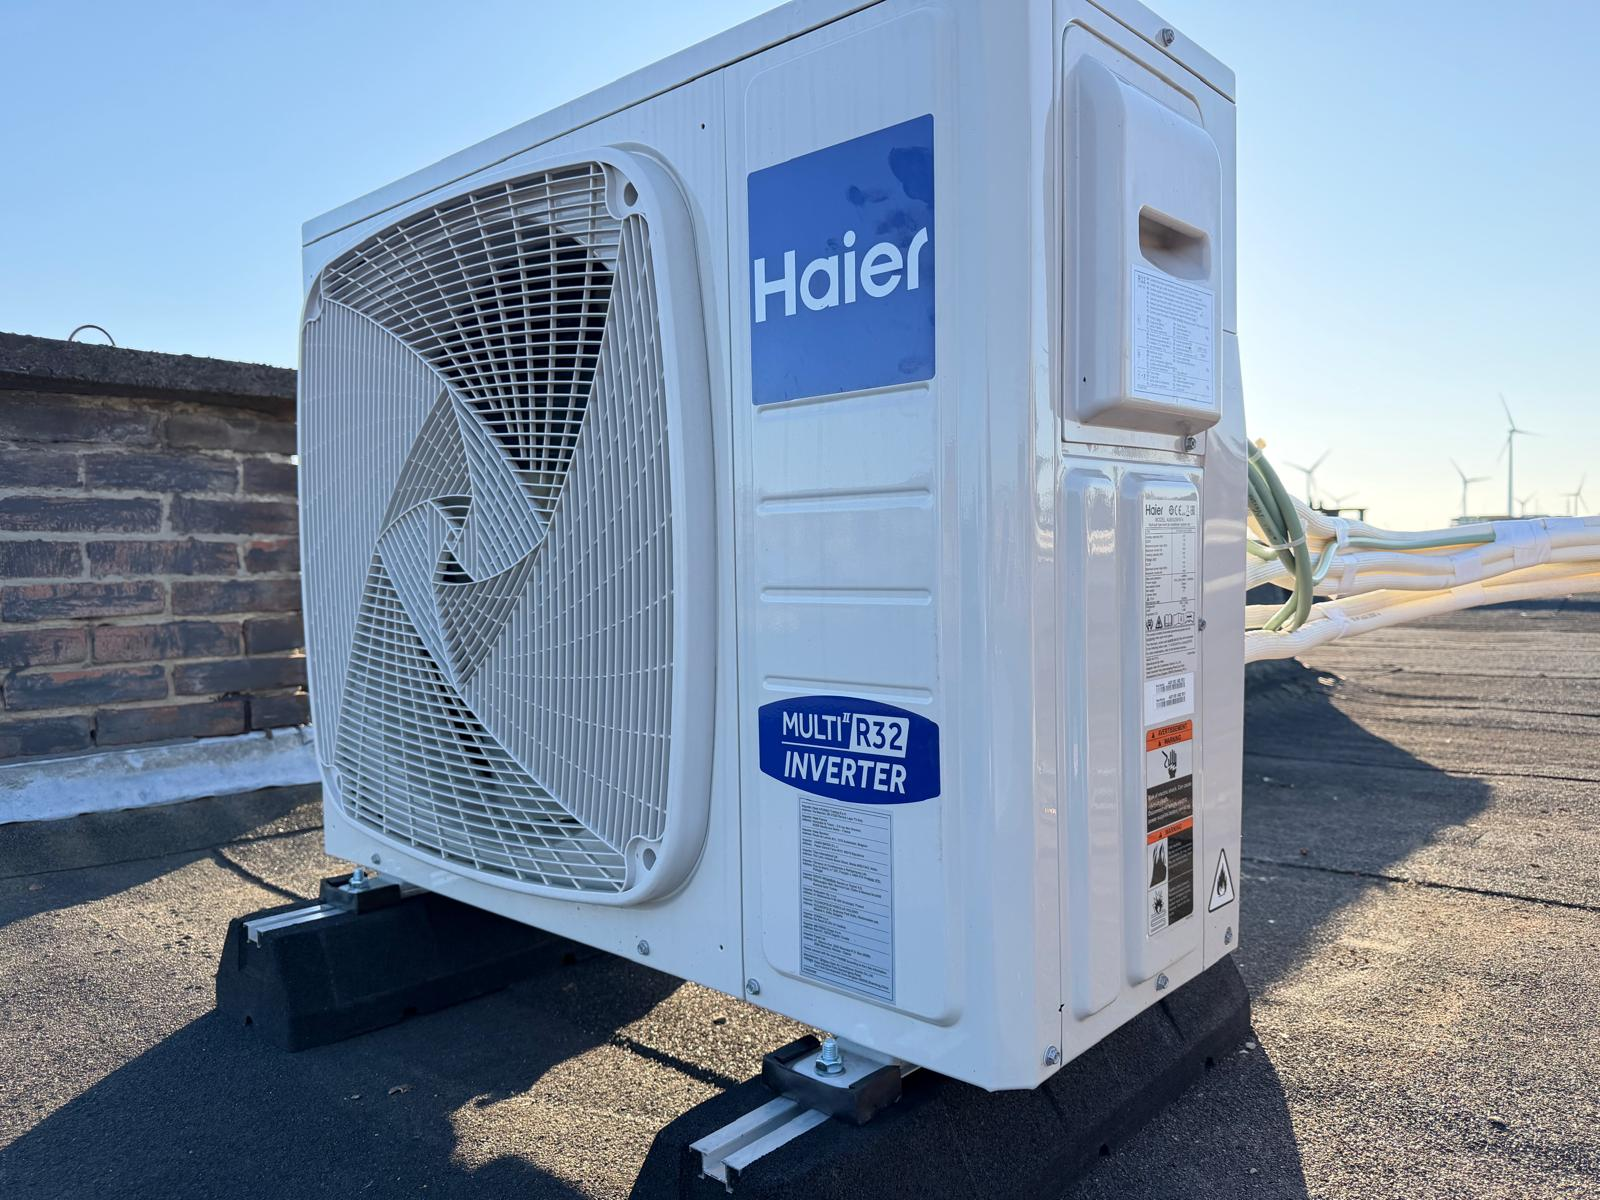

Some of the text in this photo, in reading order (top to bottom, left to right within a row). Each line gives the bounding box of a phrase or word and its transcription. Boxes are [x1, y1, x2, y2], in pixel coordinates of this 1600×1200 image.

[754, 226, 928, 322] Haier
[1145, 504, 1163, 516] Haier
[782, 711, 842, 742] MULTI
[856, 717, 903, 751] R32
[784, 751, 907, 794] INVERTER
